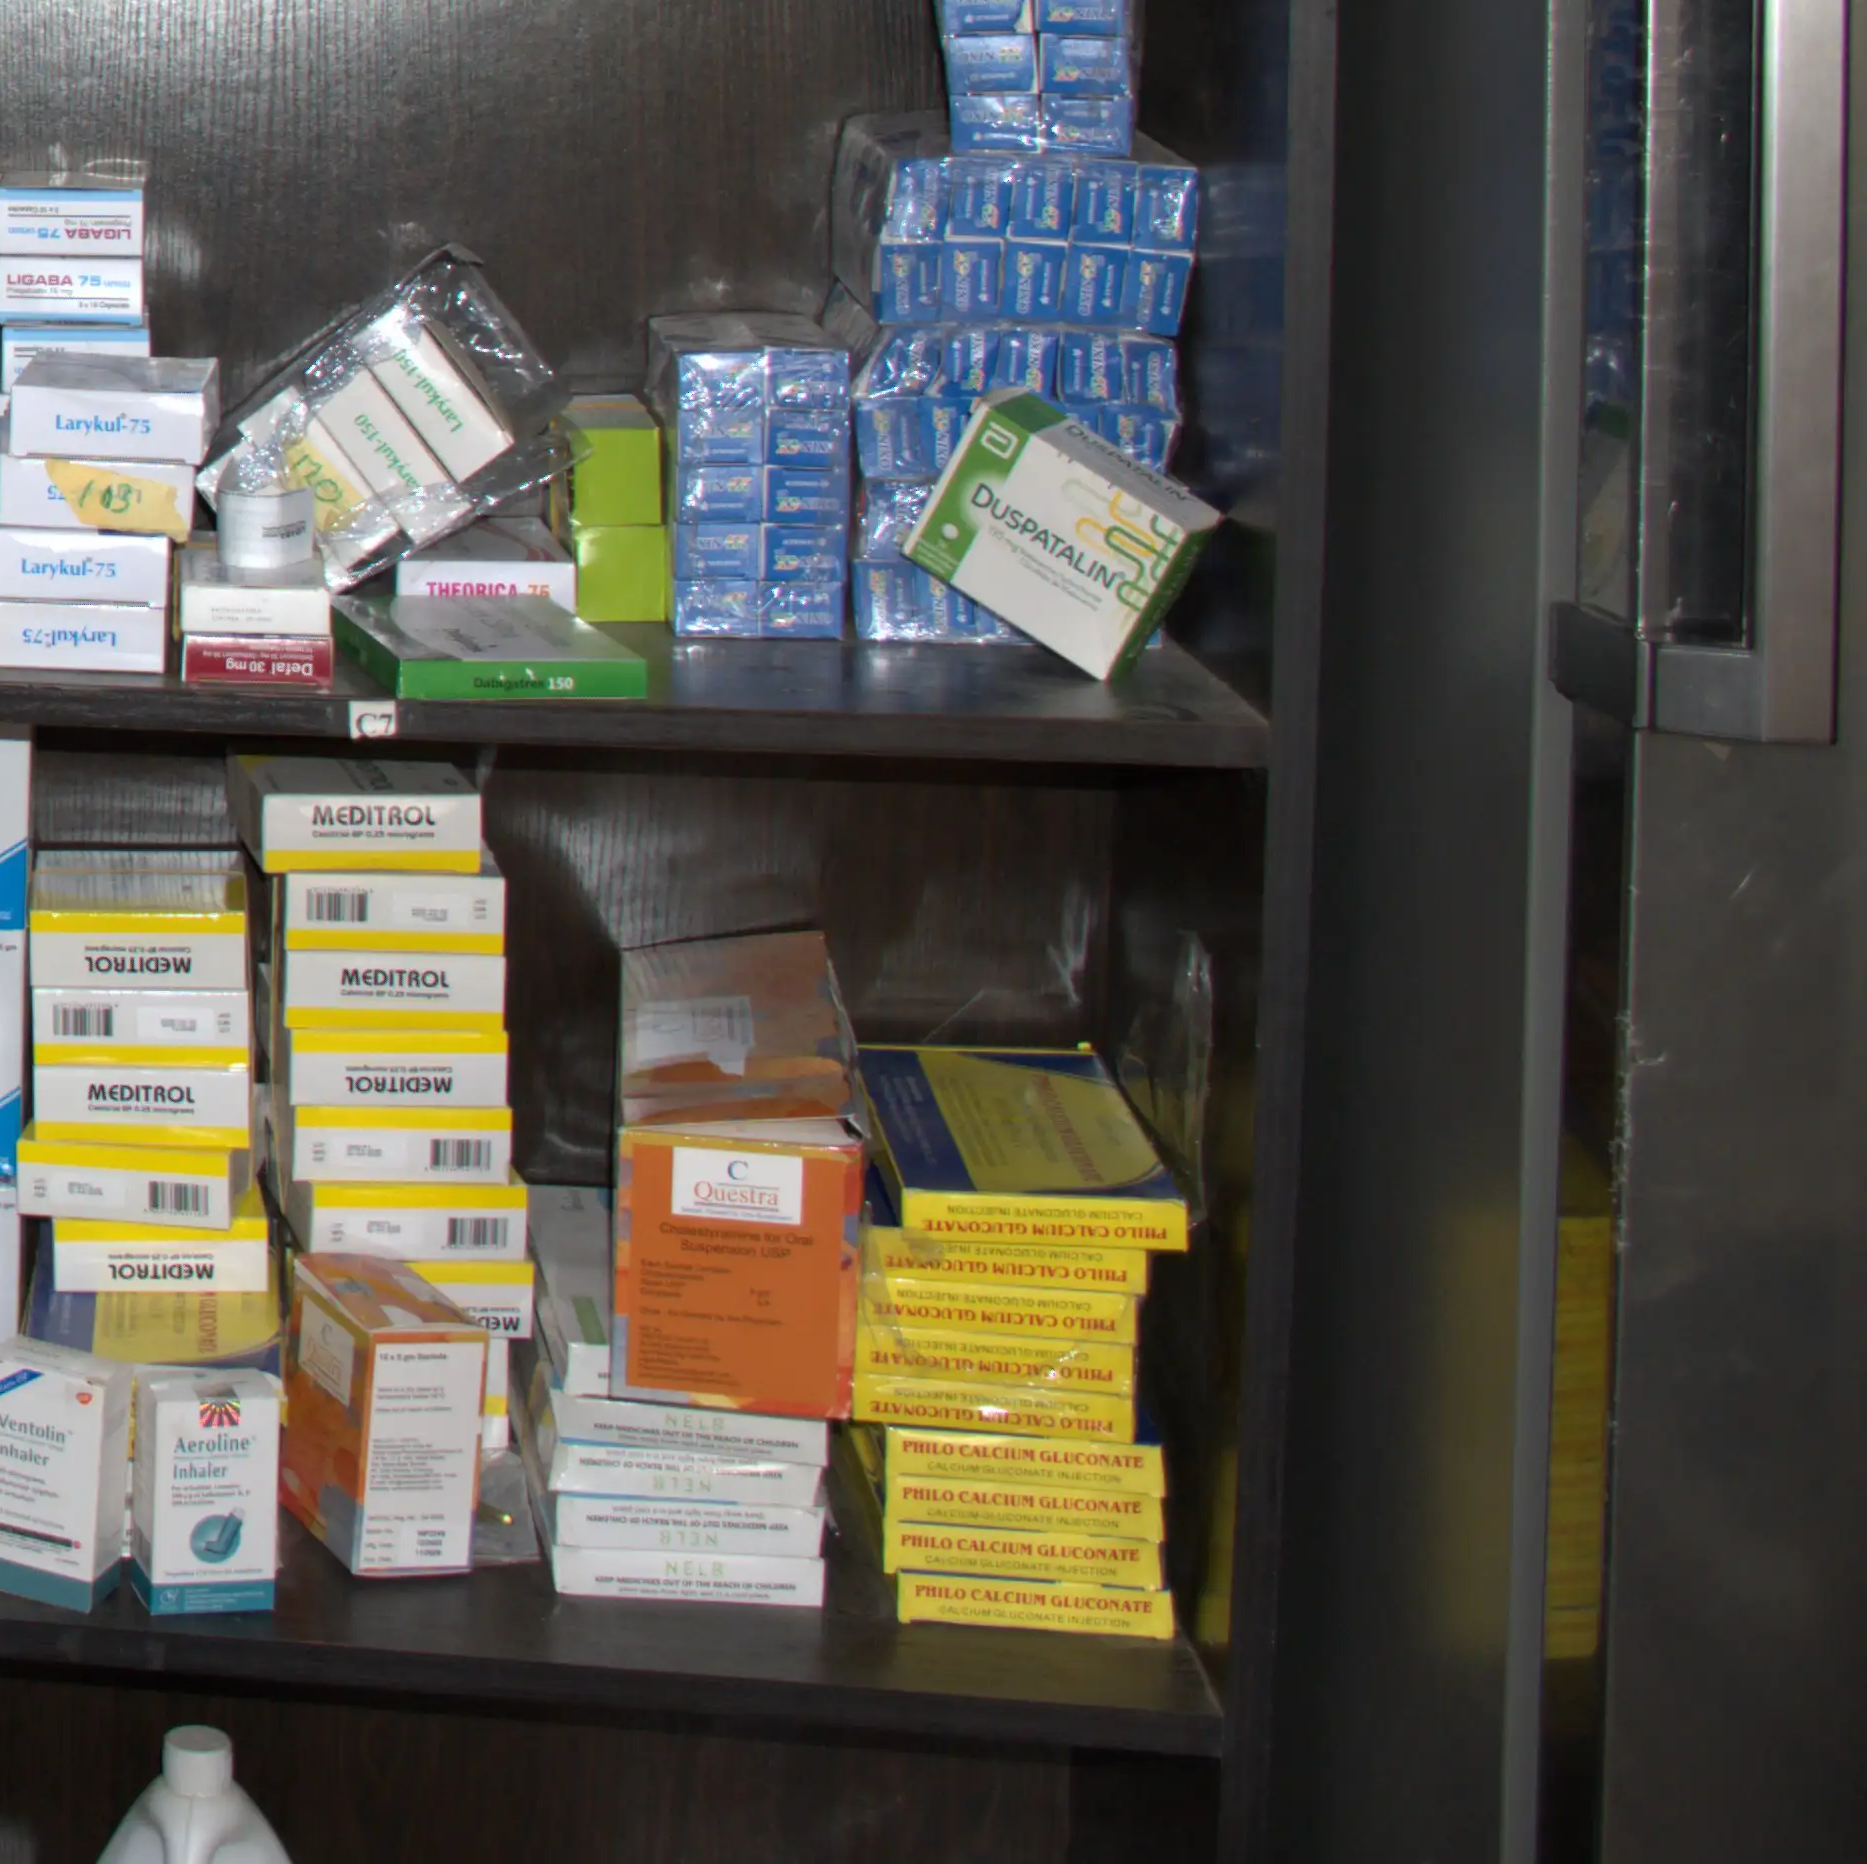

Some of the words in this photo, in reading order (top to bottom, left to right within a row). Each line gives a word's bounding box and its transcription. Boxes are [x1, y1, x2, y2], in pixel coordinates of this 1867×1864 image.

[7, 275, 73, 286] LIGABA
[78, 276, 101, 286] 75
[971, 482, 1116, 589] DUSPATALIN
[356, 713, 393, 737] C7
[312, 804, 436, 826] MEDITROL
[88, 1084, 194, 1103] MEDITROL
[694, 1181, 779, 1207] Questra
[174, 1436, 250, 1454] Aeroline
[902, 1441, 952, 1455] PHILO
[954, 1443, 1036, 1461] CALCIUM
[1039, 1450, 1144, 1468] GLUCONATE
[173, 1463, 228, 1479] Inhaler
